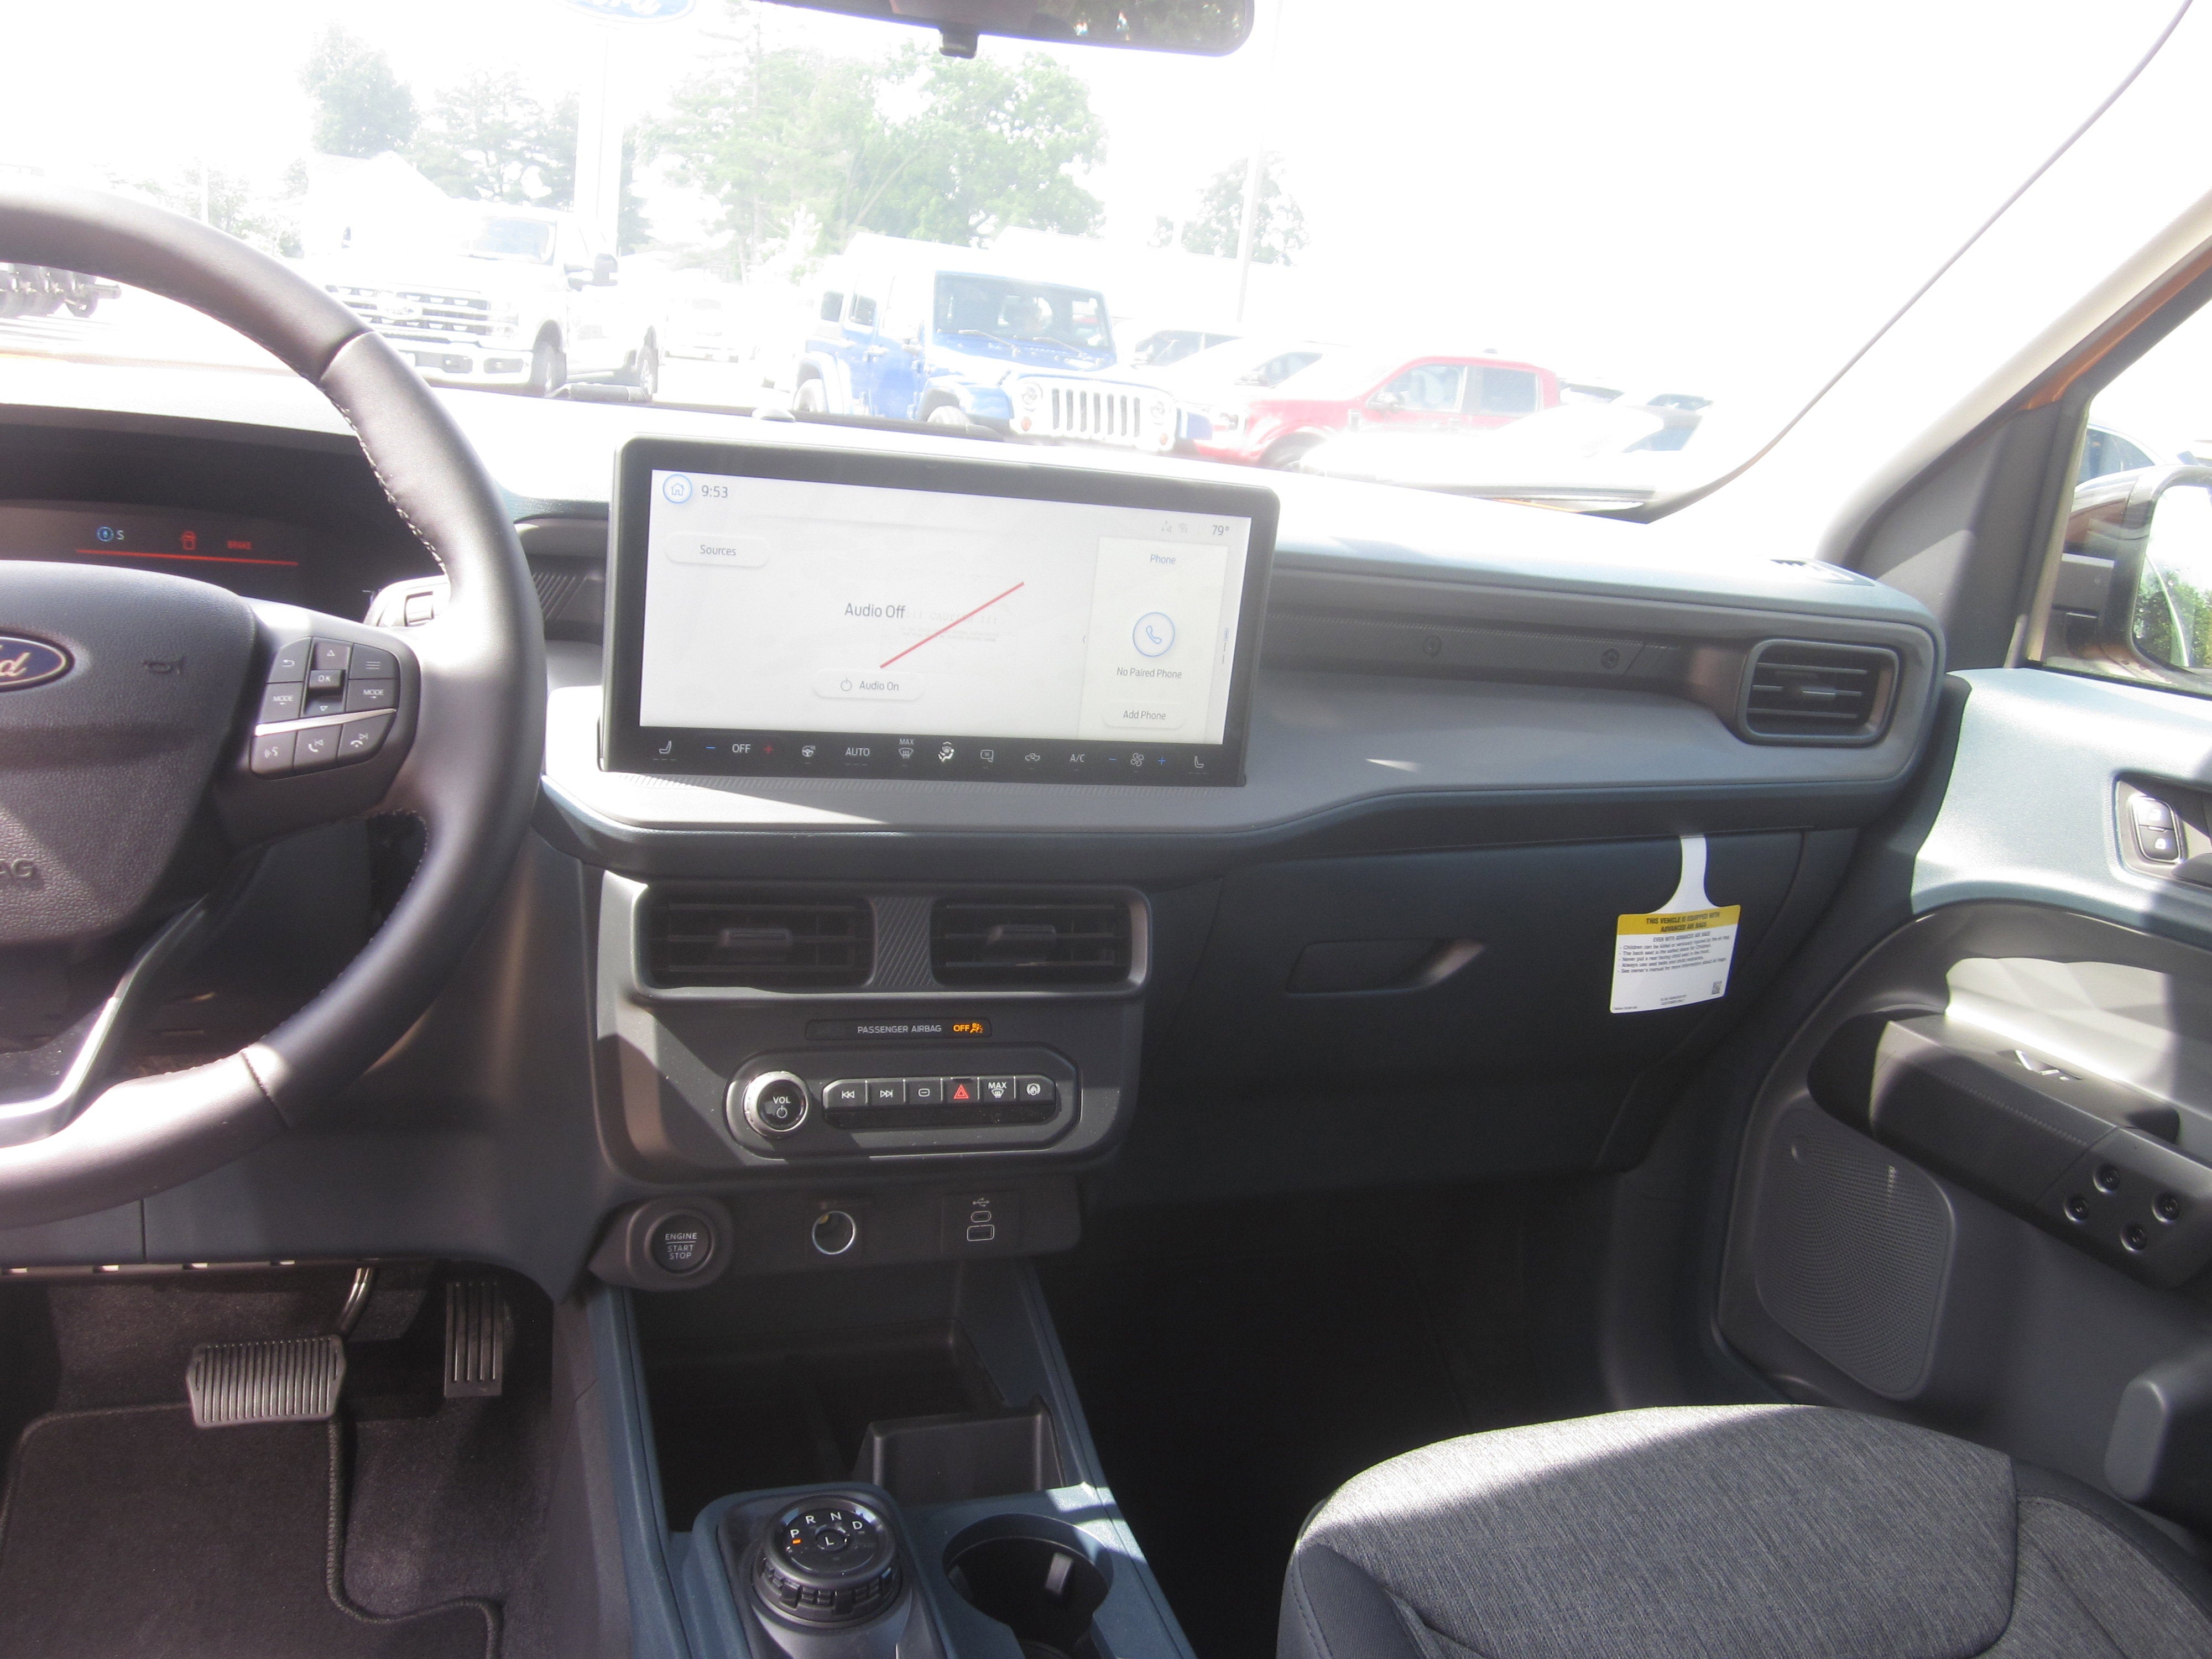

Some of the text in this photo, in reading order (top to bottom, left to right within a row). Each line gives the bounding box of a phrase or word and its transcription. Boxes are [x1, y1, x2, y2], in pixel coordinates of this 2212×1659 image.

[701, 485, 728, 498] 9:53
[1212, 524, 1229, 535] 79°
[117, 530, 124, 540] S
[227, 540, 252, 550] BRAKE
[700, 544, 737, 556] Sources
[1150, 554, 1176, 565] Phone
[844, 602, 906, 618] Audio Off
[1117, 667, 1182, 679] No Paired Phone
[859, 680, 899, 691] Audio On
[1123, 710, 1166, 721] Add Phone
[732, 743, 751, 753] OFF
[845, 747, 870, 757] AUTO
[1070, 753, 1085, 763] A/C
[857, 1025, 909, 1034] PASSENGER
[911, 1024, 941, 1034] AIRBAG
[953, 1024, 970, 1033] OFF
[773, 1095, 791, 1104] VOL
[667, 1244, 693, 1253] START
[790, 1511, 863, 1538] P R N D
[825, 1536, 834, 1546] L
